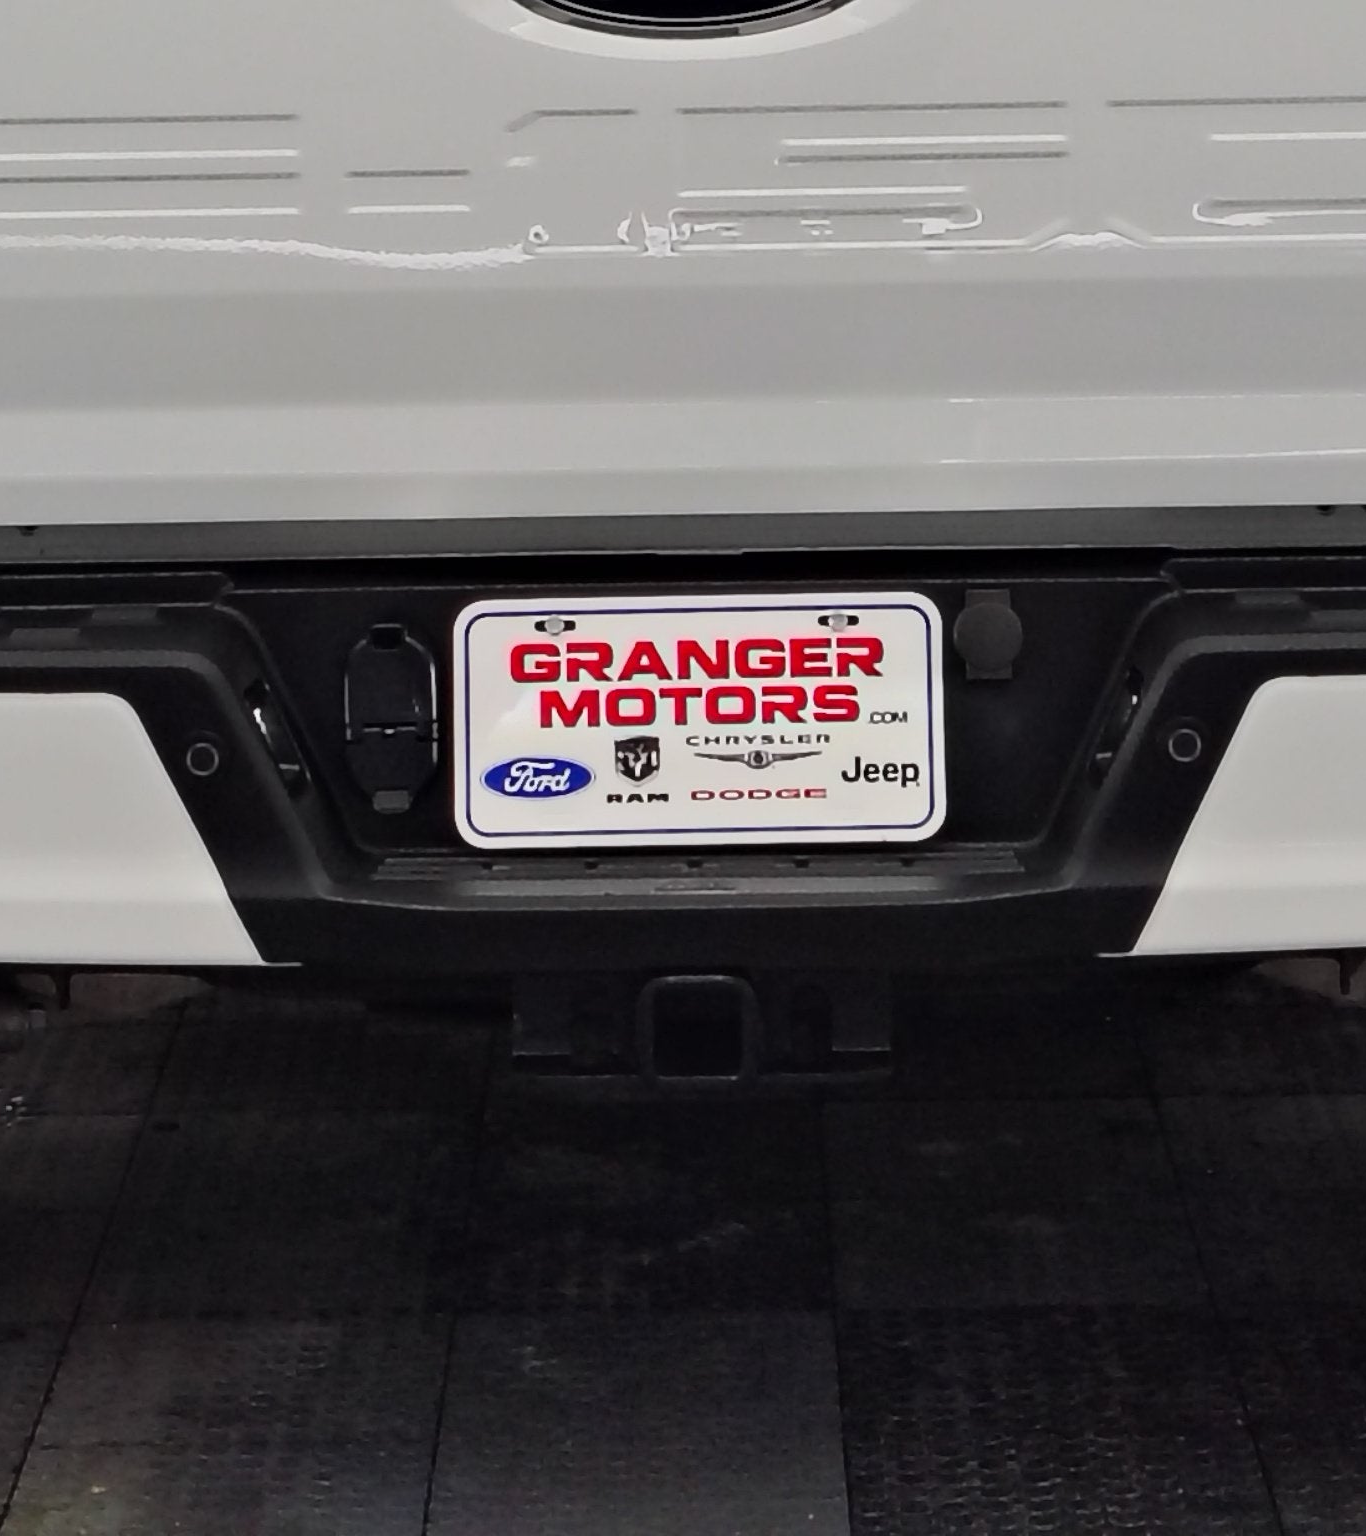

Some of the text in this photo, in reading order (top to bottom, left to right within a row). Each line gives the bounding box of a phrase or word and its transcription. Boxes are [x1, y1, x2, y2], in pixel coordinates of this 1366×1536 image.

[510, 637, 883, 683] GRANGER
[540, 685, 861, 728] MOTORS
[685, 734, 831, 746] CHRYSLER
[503, 762, 571, 794] Ford
[841, 756, 920, 787] Jeep
[606, 793, 670, 803] RAM
[690, 788, 828, 801] DODGE
